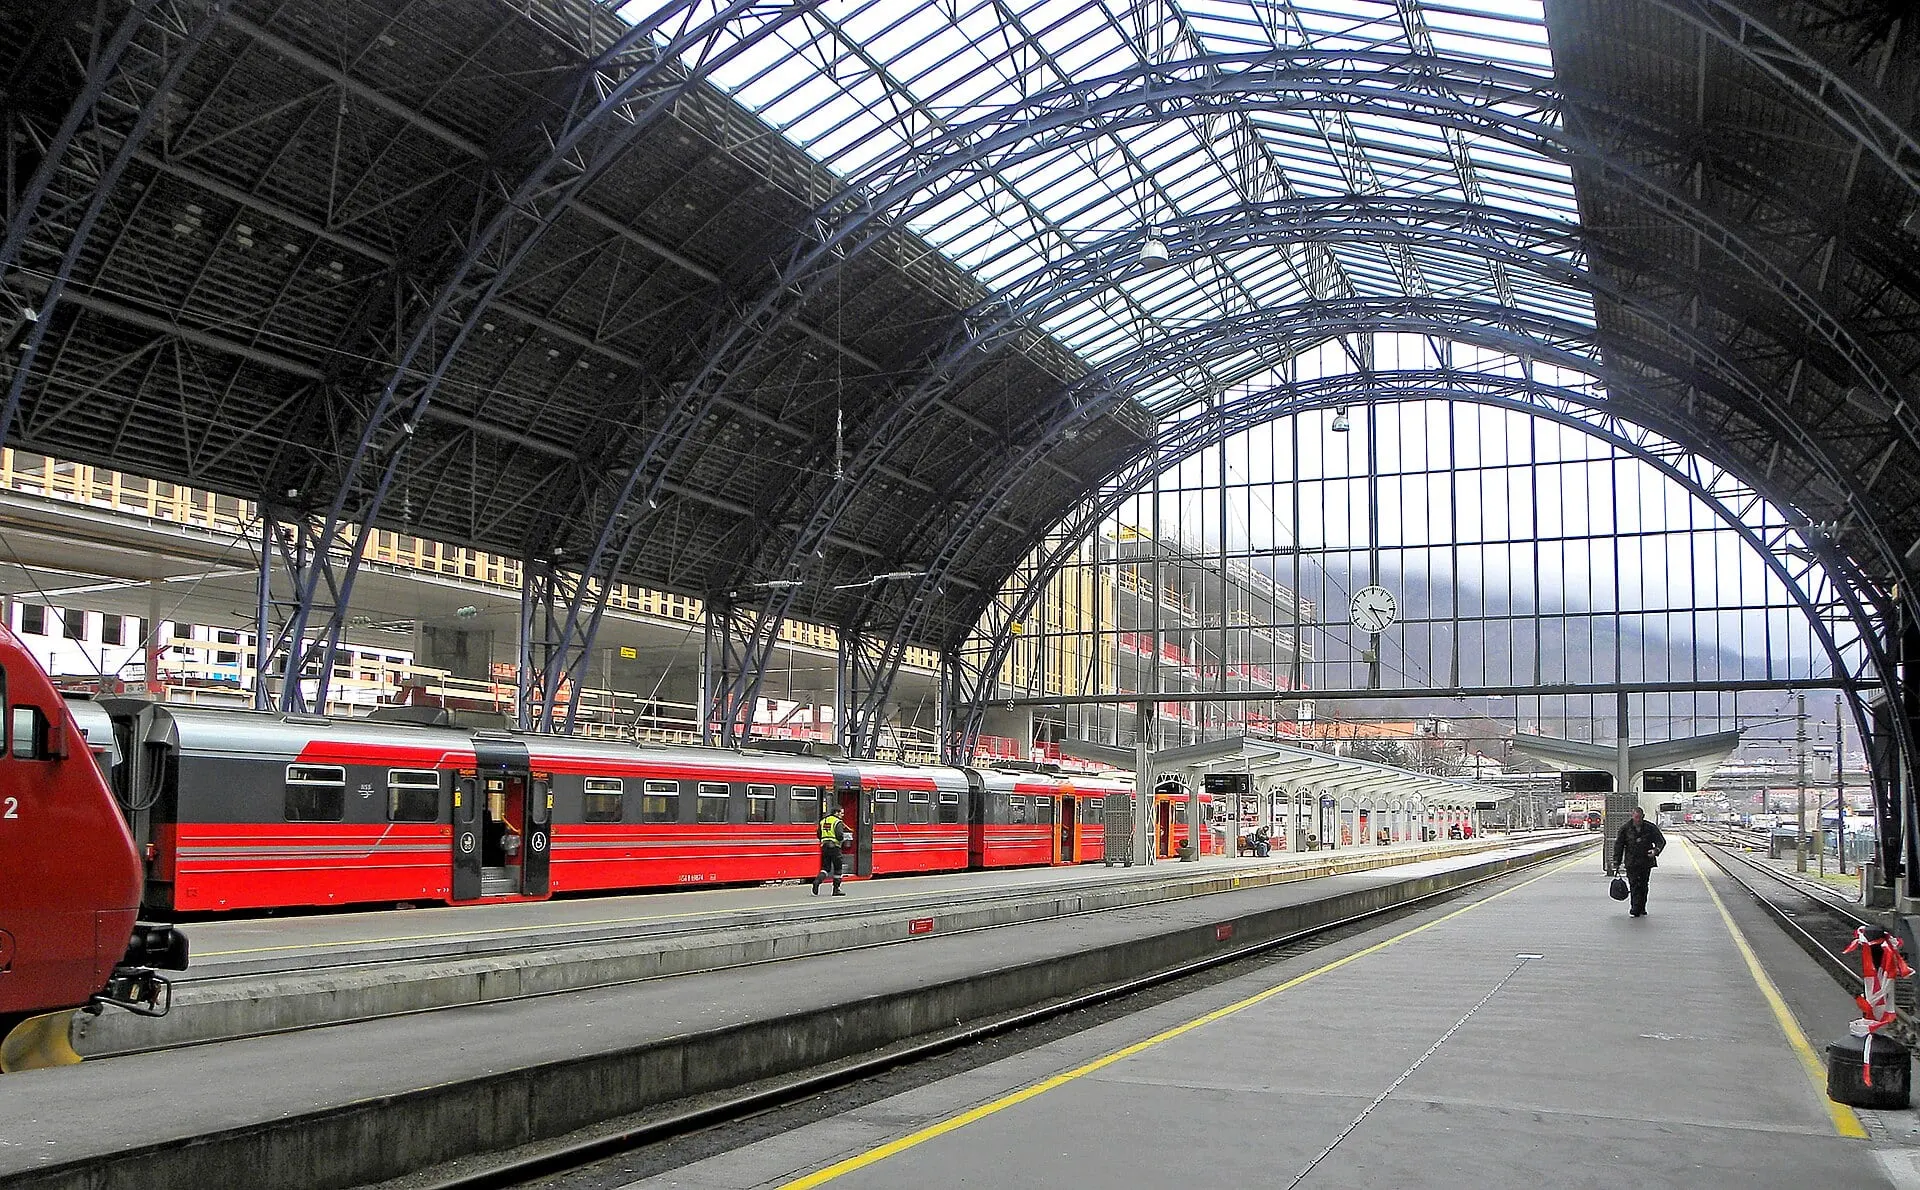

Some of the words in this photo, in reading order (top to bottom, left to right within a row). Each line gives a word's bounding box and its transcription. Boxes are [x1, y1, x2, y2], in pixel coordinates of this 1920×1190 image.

[1241, 782, 1246, 791] 3
[1565, 781, 1570, 789] 2
[1687, 781, 1692, 789] 1
[4, 796, 18, 819] 2
